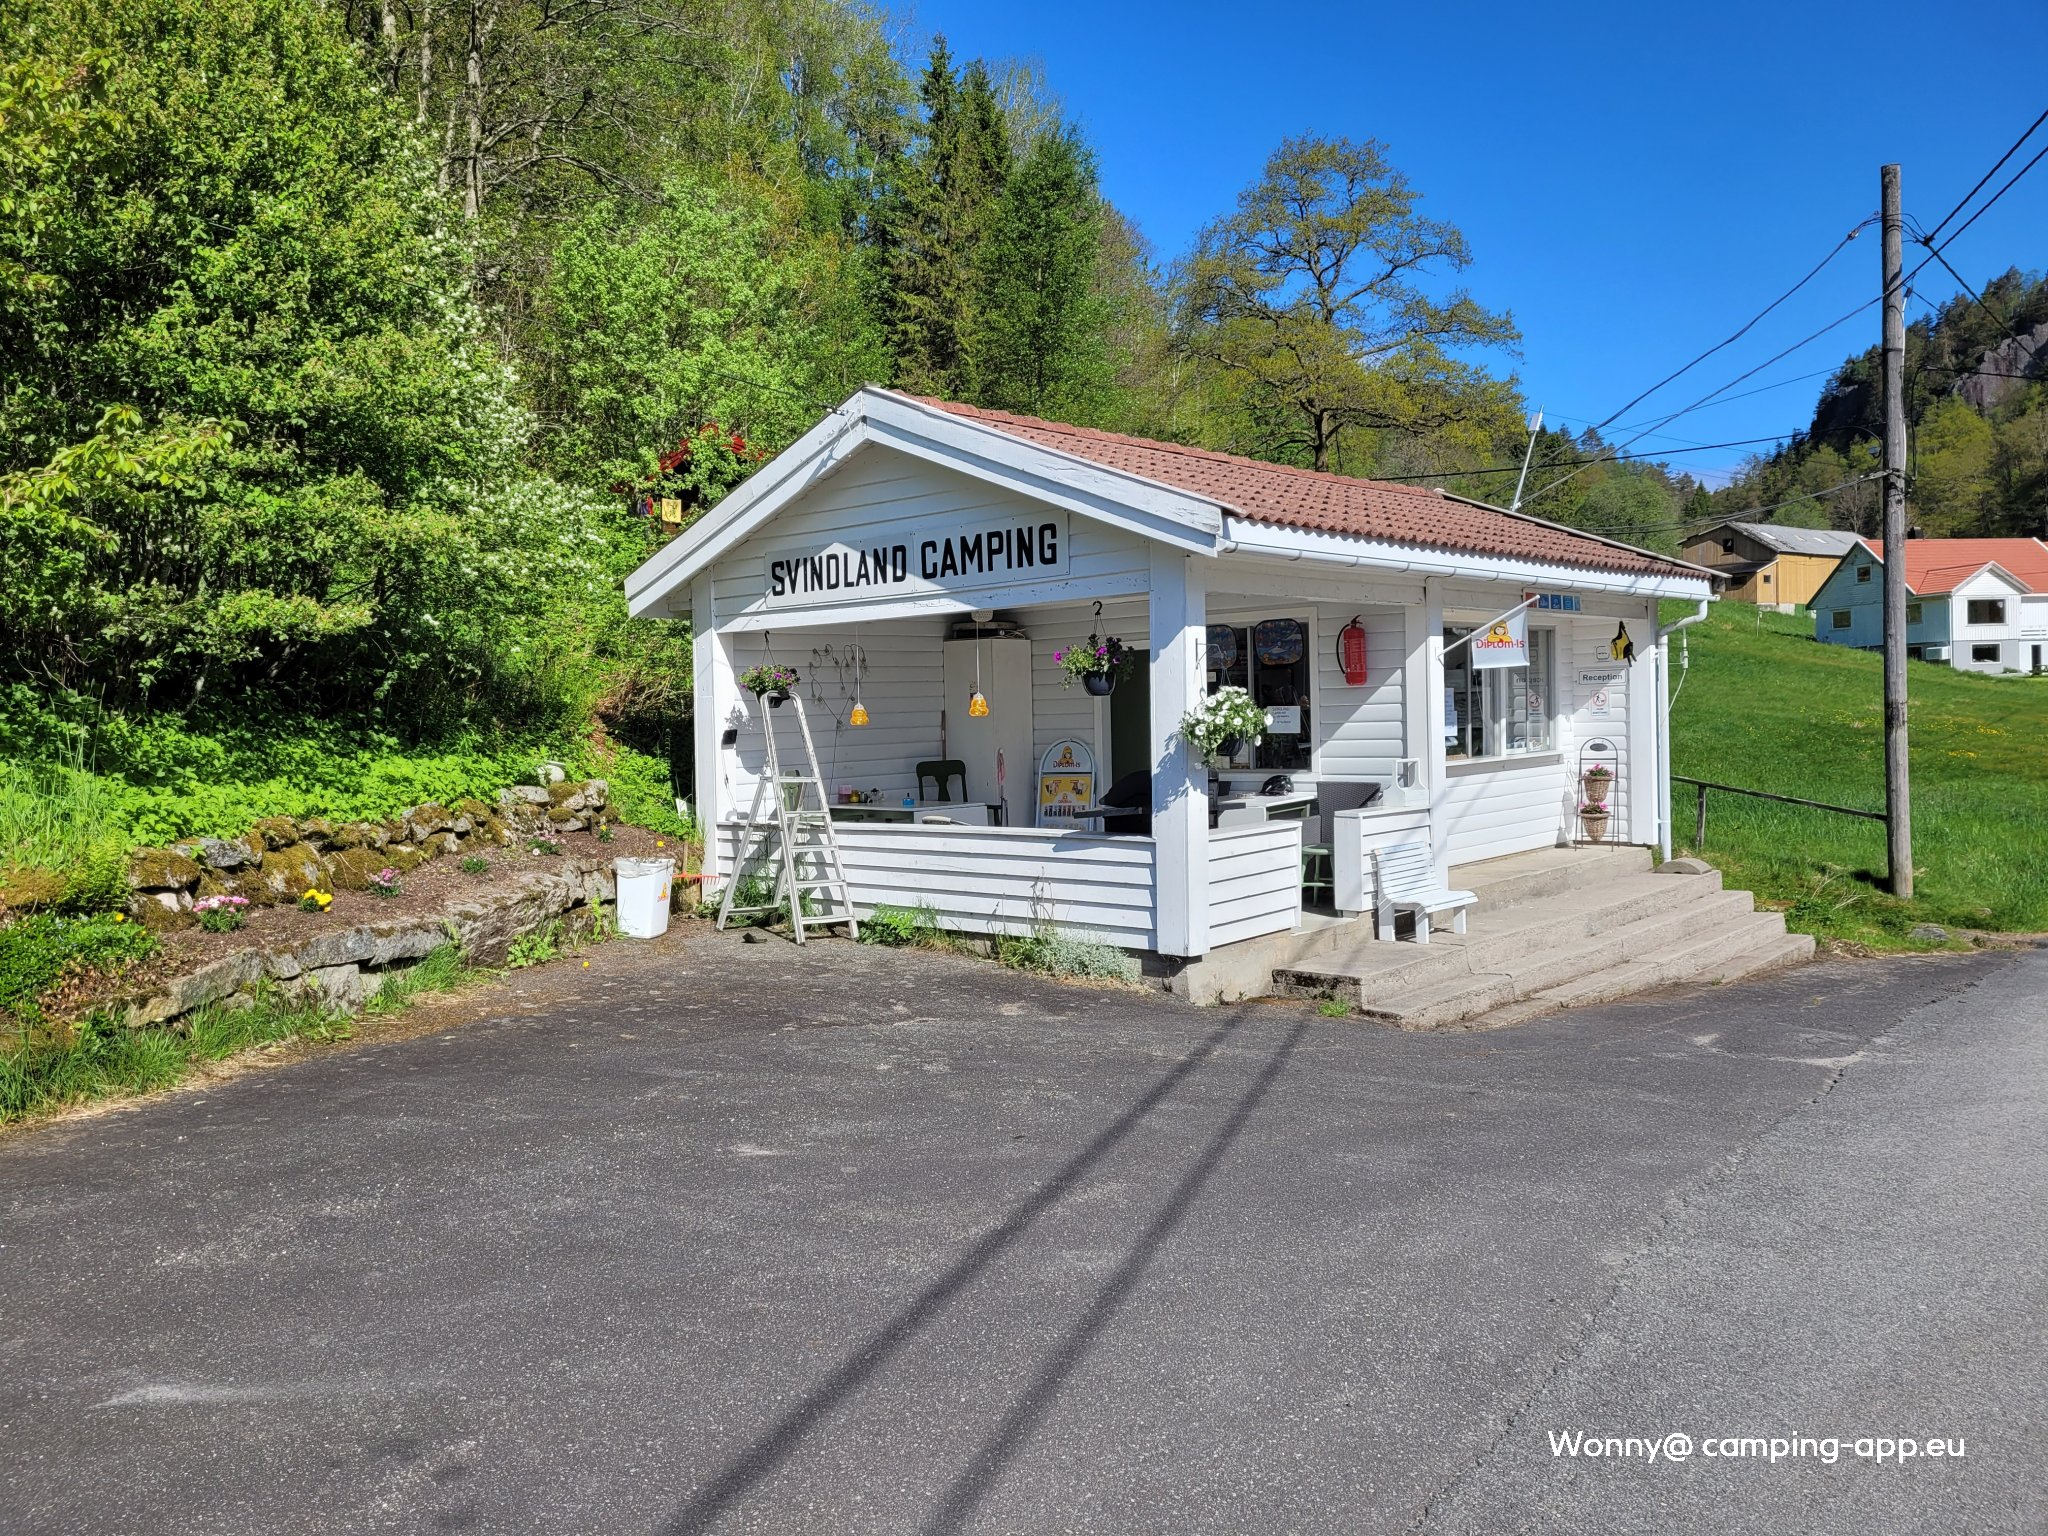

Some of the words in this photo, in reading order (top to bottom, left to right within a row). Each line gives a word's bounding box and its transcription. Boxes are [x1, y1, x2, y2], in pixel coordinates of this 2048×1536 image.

[771, 543, 907, 597] SVINDLAND
[921, 522, 1058, 580] CAMPING
[1582, 673, 1623, 682] Reception
